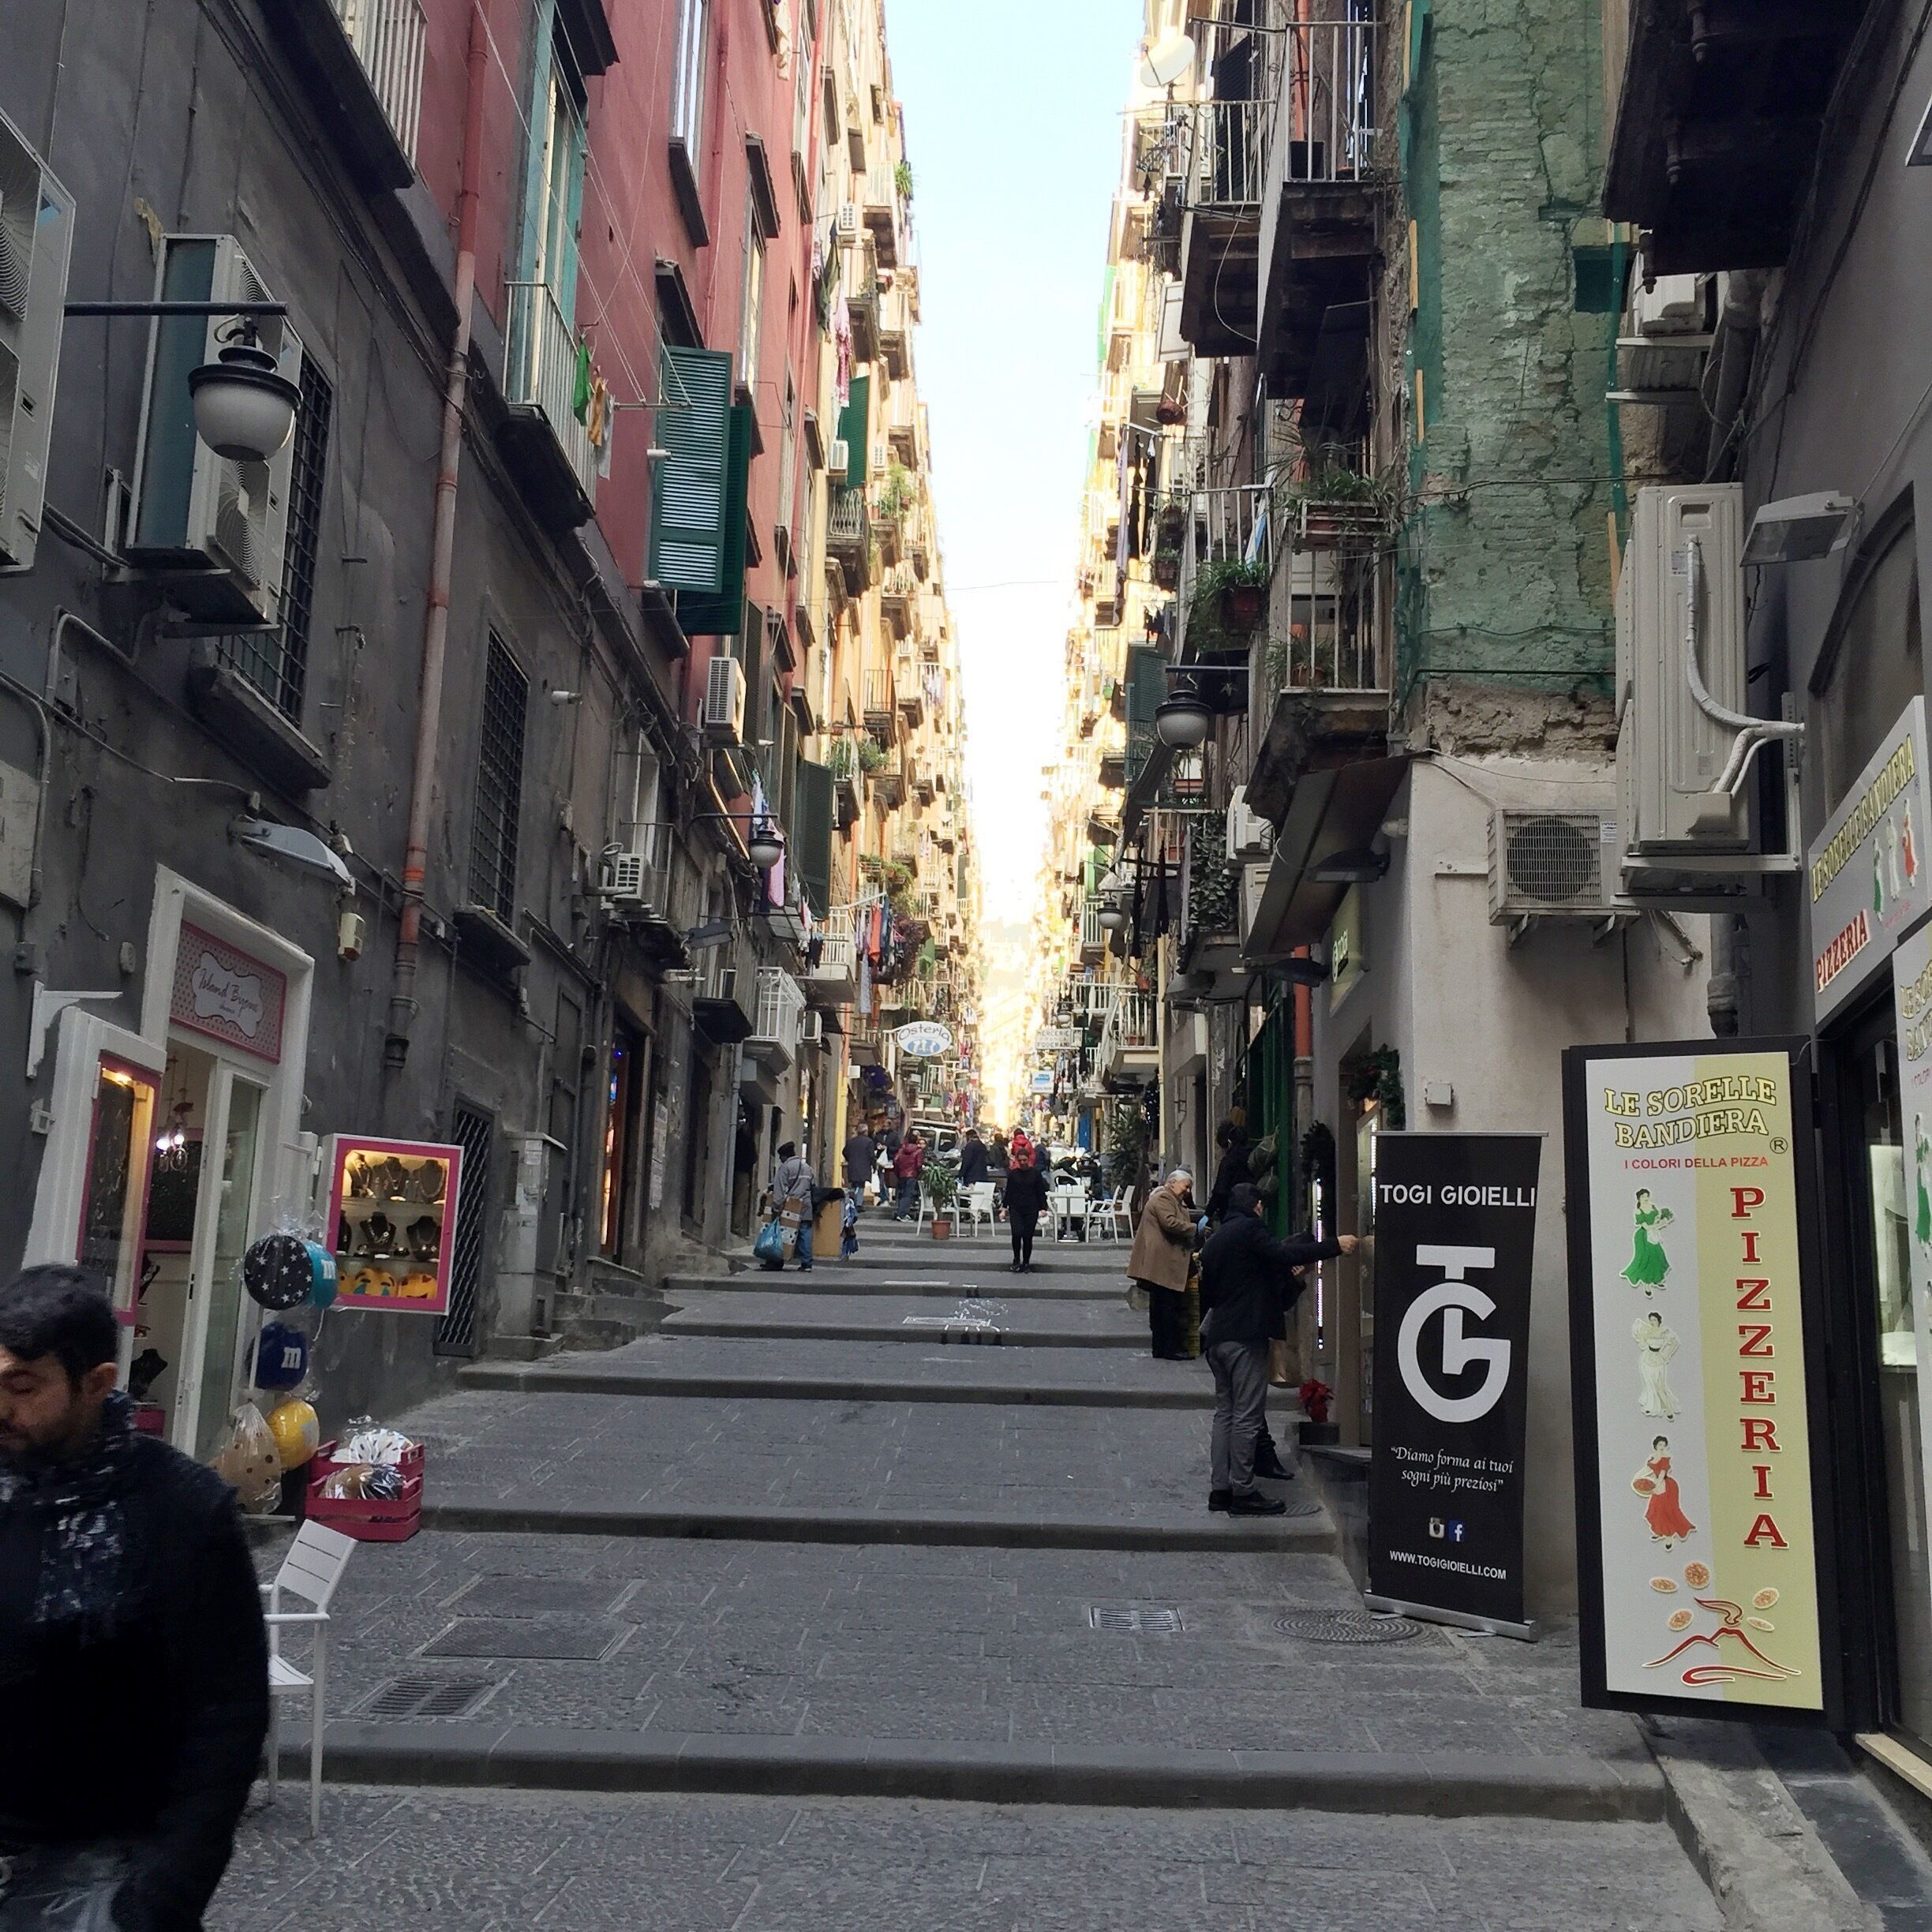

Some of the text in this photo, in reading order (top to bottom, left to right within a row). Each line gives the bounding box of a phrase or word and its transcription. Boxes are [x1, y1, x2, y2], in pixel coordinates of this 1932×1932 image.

[1811, 733, 1915, 904] LE SORELLE BANDIERA
[1816, 909, 1870, 994] PIZZERIA
[899, 1024, 950, 1042] Osteria
[1604, 1076, 1777, 1117] LE SORELLE
[1615, 1109, 1769, 1148] BANDIERA
[1624, 1156, 1769, 1169] I COLORI DELLA PIZZA
[1380, 1184, 1536, 1207] TOGI GIOIELLI
[281, 1346, 302, 1369] m
[1730, 1186, 1789, 1549] PIZZERIA
[1433, 1448, 1470, 1470] forma
[1473, 1457, 1486, 1470] ai
[1489, 1460, 1514, 1473] tuoi
[1401, 1470, 1431, 1487] sogni
[1429, 1472, 1451, 1490] più
[1389, 1550, 1507, 1580] WWW.TOGIGIOIELLI.COM
